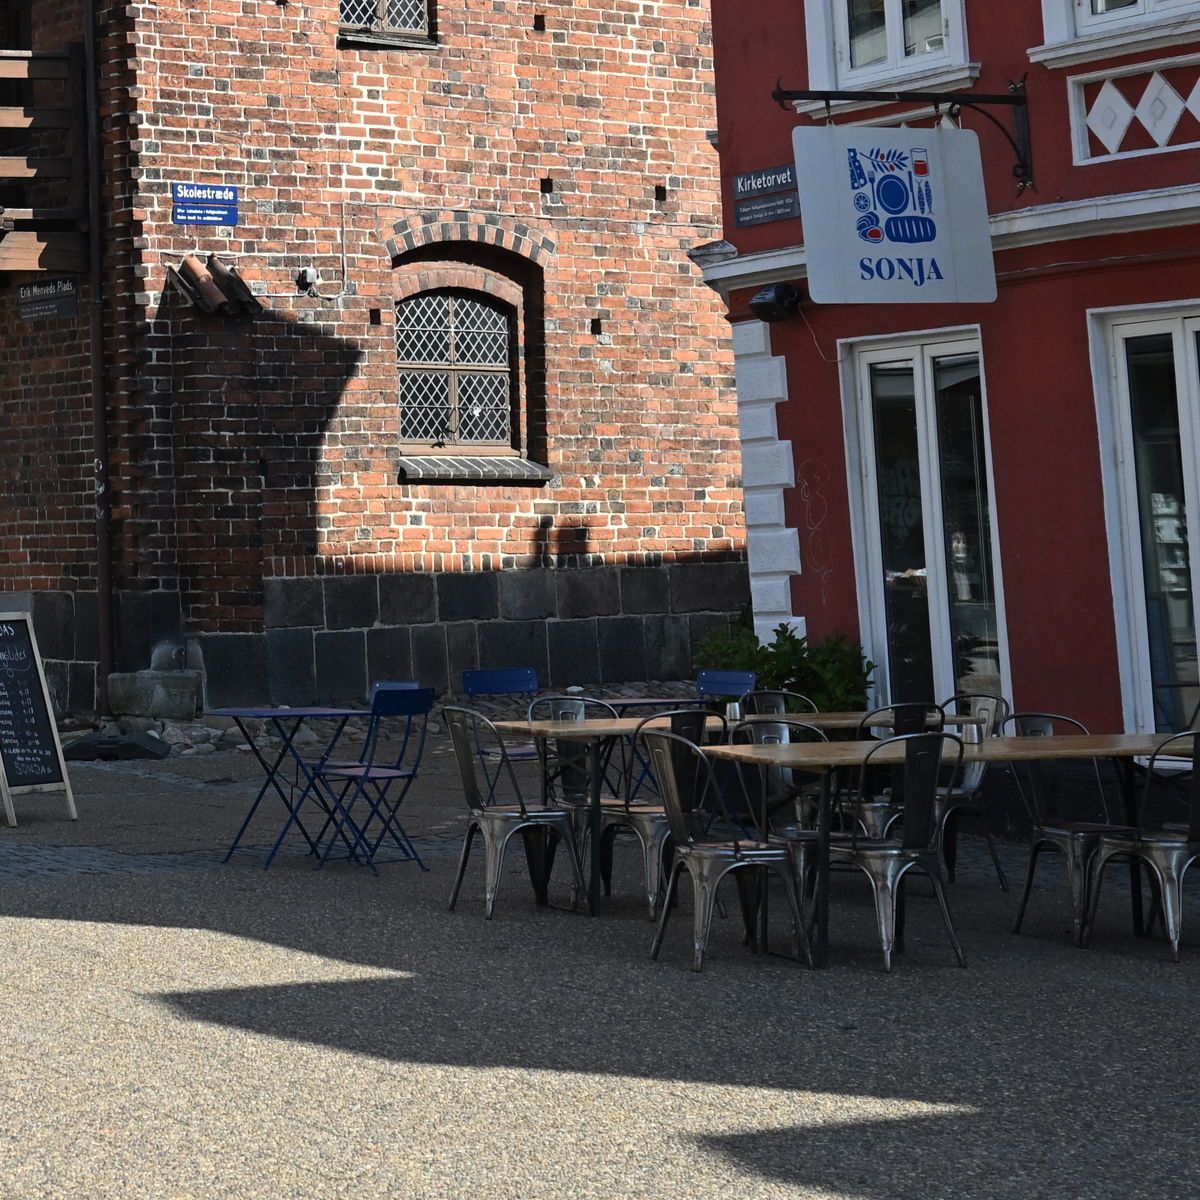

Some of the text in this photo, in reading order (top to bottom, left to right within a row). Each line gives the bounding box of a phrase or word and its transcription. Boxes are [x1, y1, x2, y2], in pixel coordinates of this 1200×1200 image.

[737, 168, 792, 193] Kirketorvet
[176, 184, 234, 200] Skolestræde
[859, 257, 944, 287] SONJA
[20, 279, 73, 299] Erik Menveds Plads
